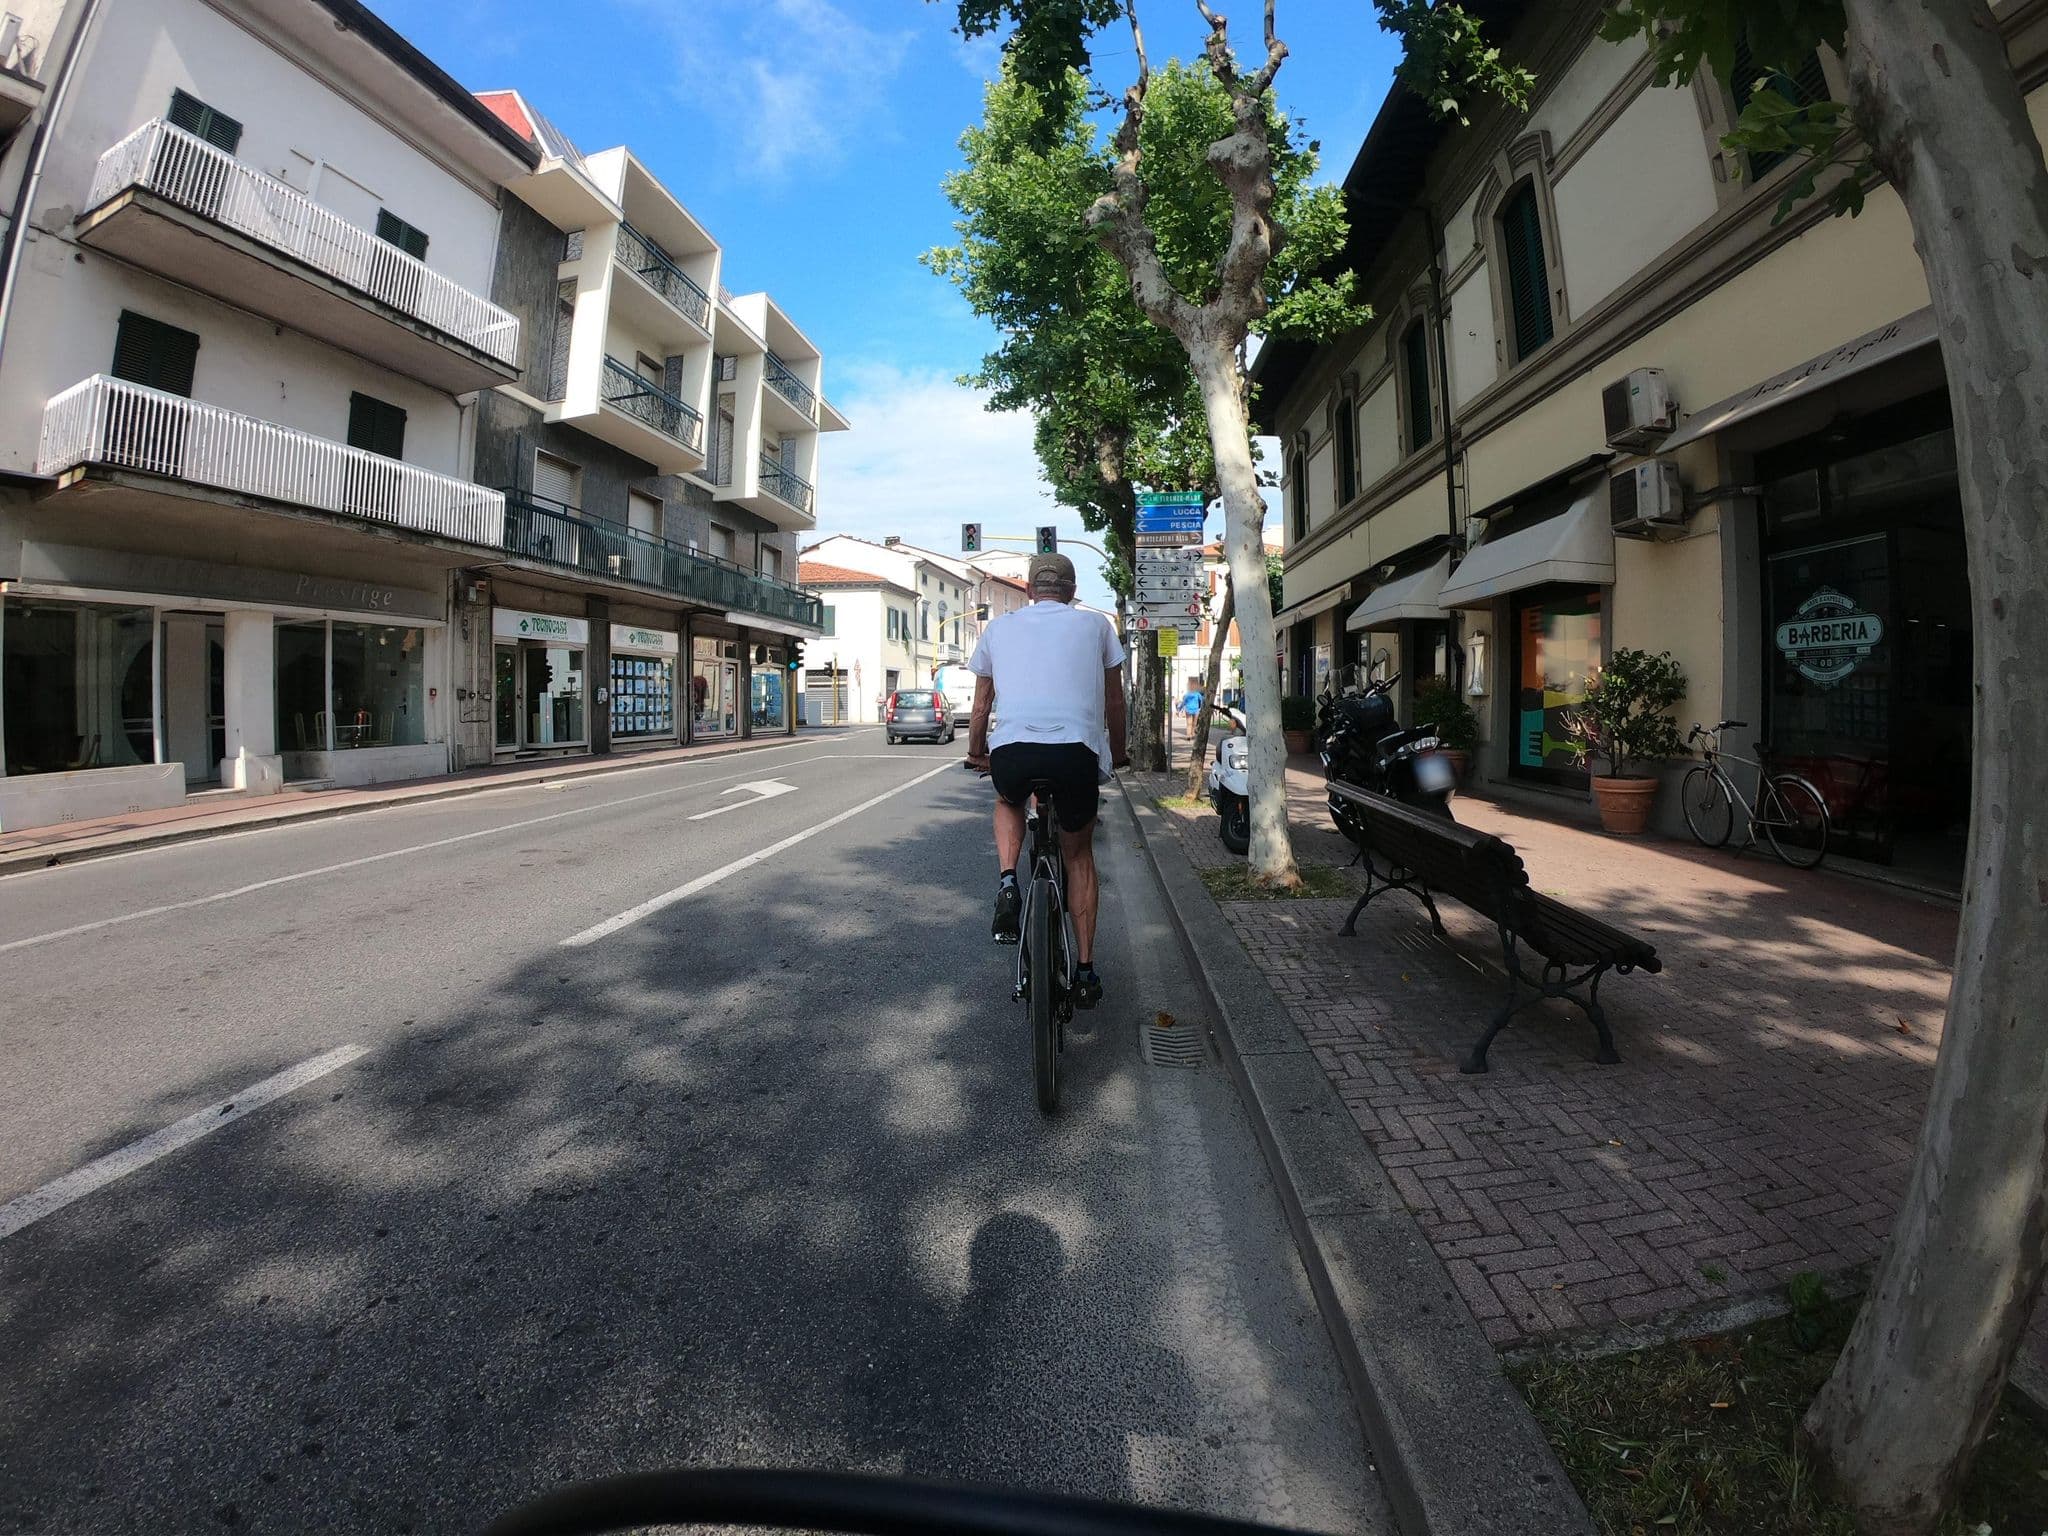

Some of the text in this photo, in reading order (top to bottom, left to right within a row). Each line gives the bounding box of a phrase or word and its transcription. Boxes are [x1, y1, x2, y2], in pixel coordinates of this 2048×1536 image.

[1173, 508, 1202, 516] LUCCA
[1170, 521, 1202, 529] PESCIA
[532, 617, 567, 635] TECNOCASA
[1788, 621, 1868, 646] BARBERIA
